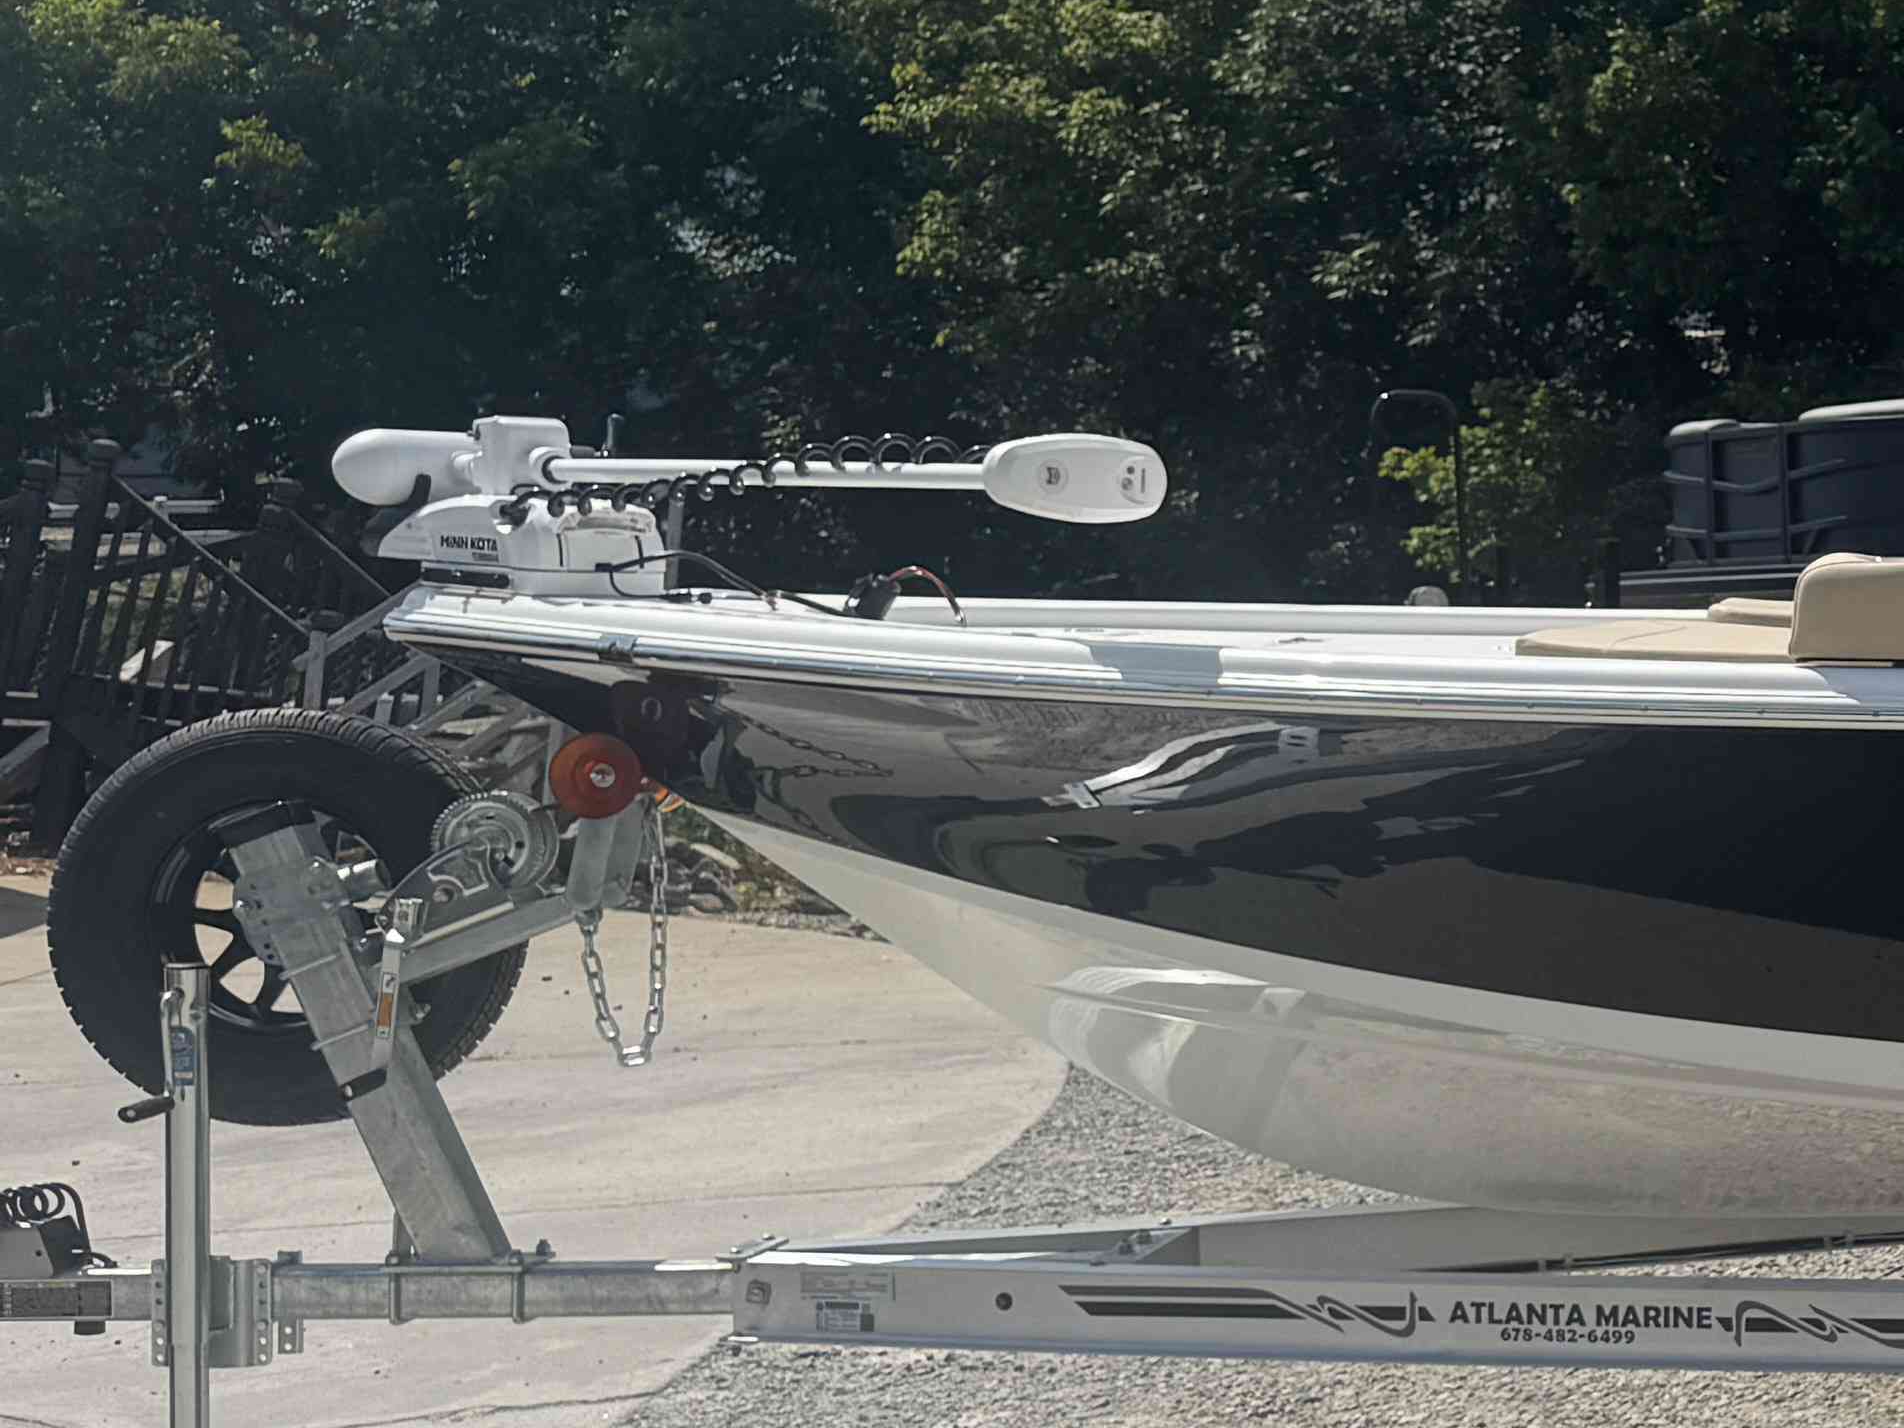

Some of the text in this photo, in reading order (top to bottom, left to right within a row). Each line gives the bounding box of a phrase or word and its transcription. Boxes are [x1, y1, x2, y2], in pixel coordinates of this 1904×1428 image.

[1448, 1301, 1713, 1330] ATLANTA MARINE
[1500, 1327, 1636, 1345] 678-482-6499
